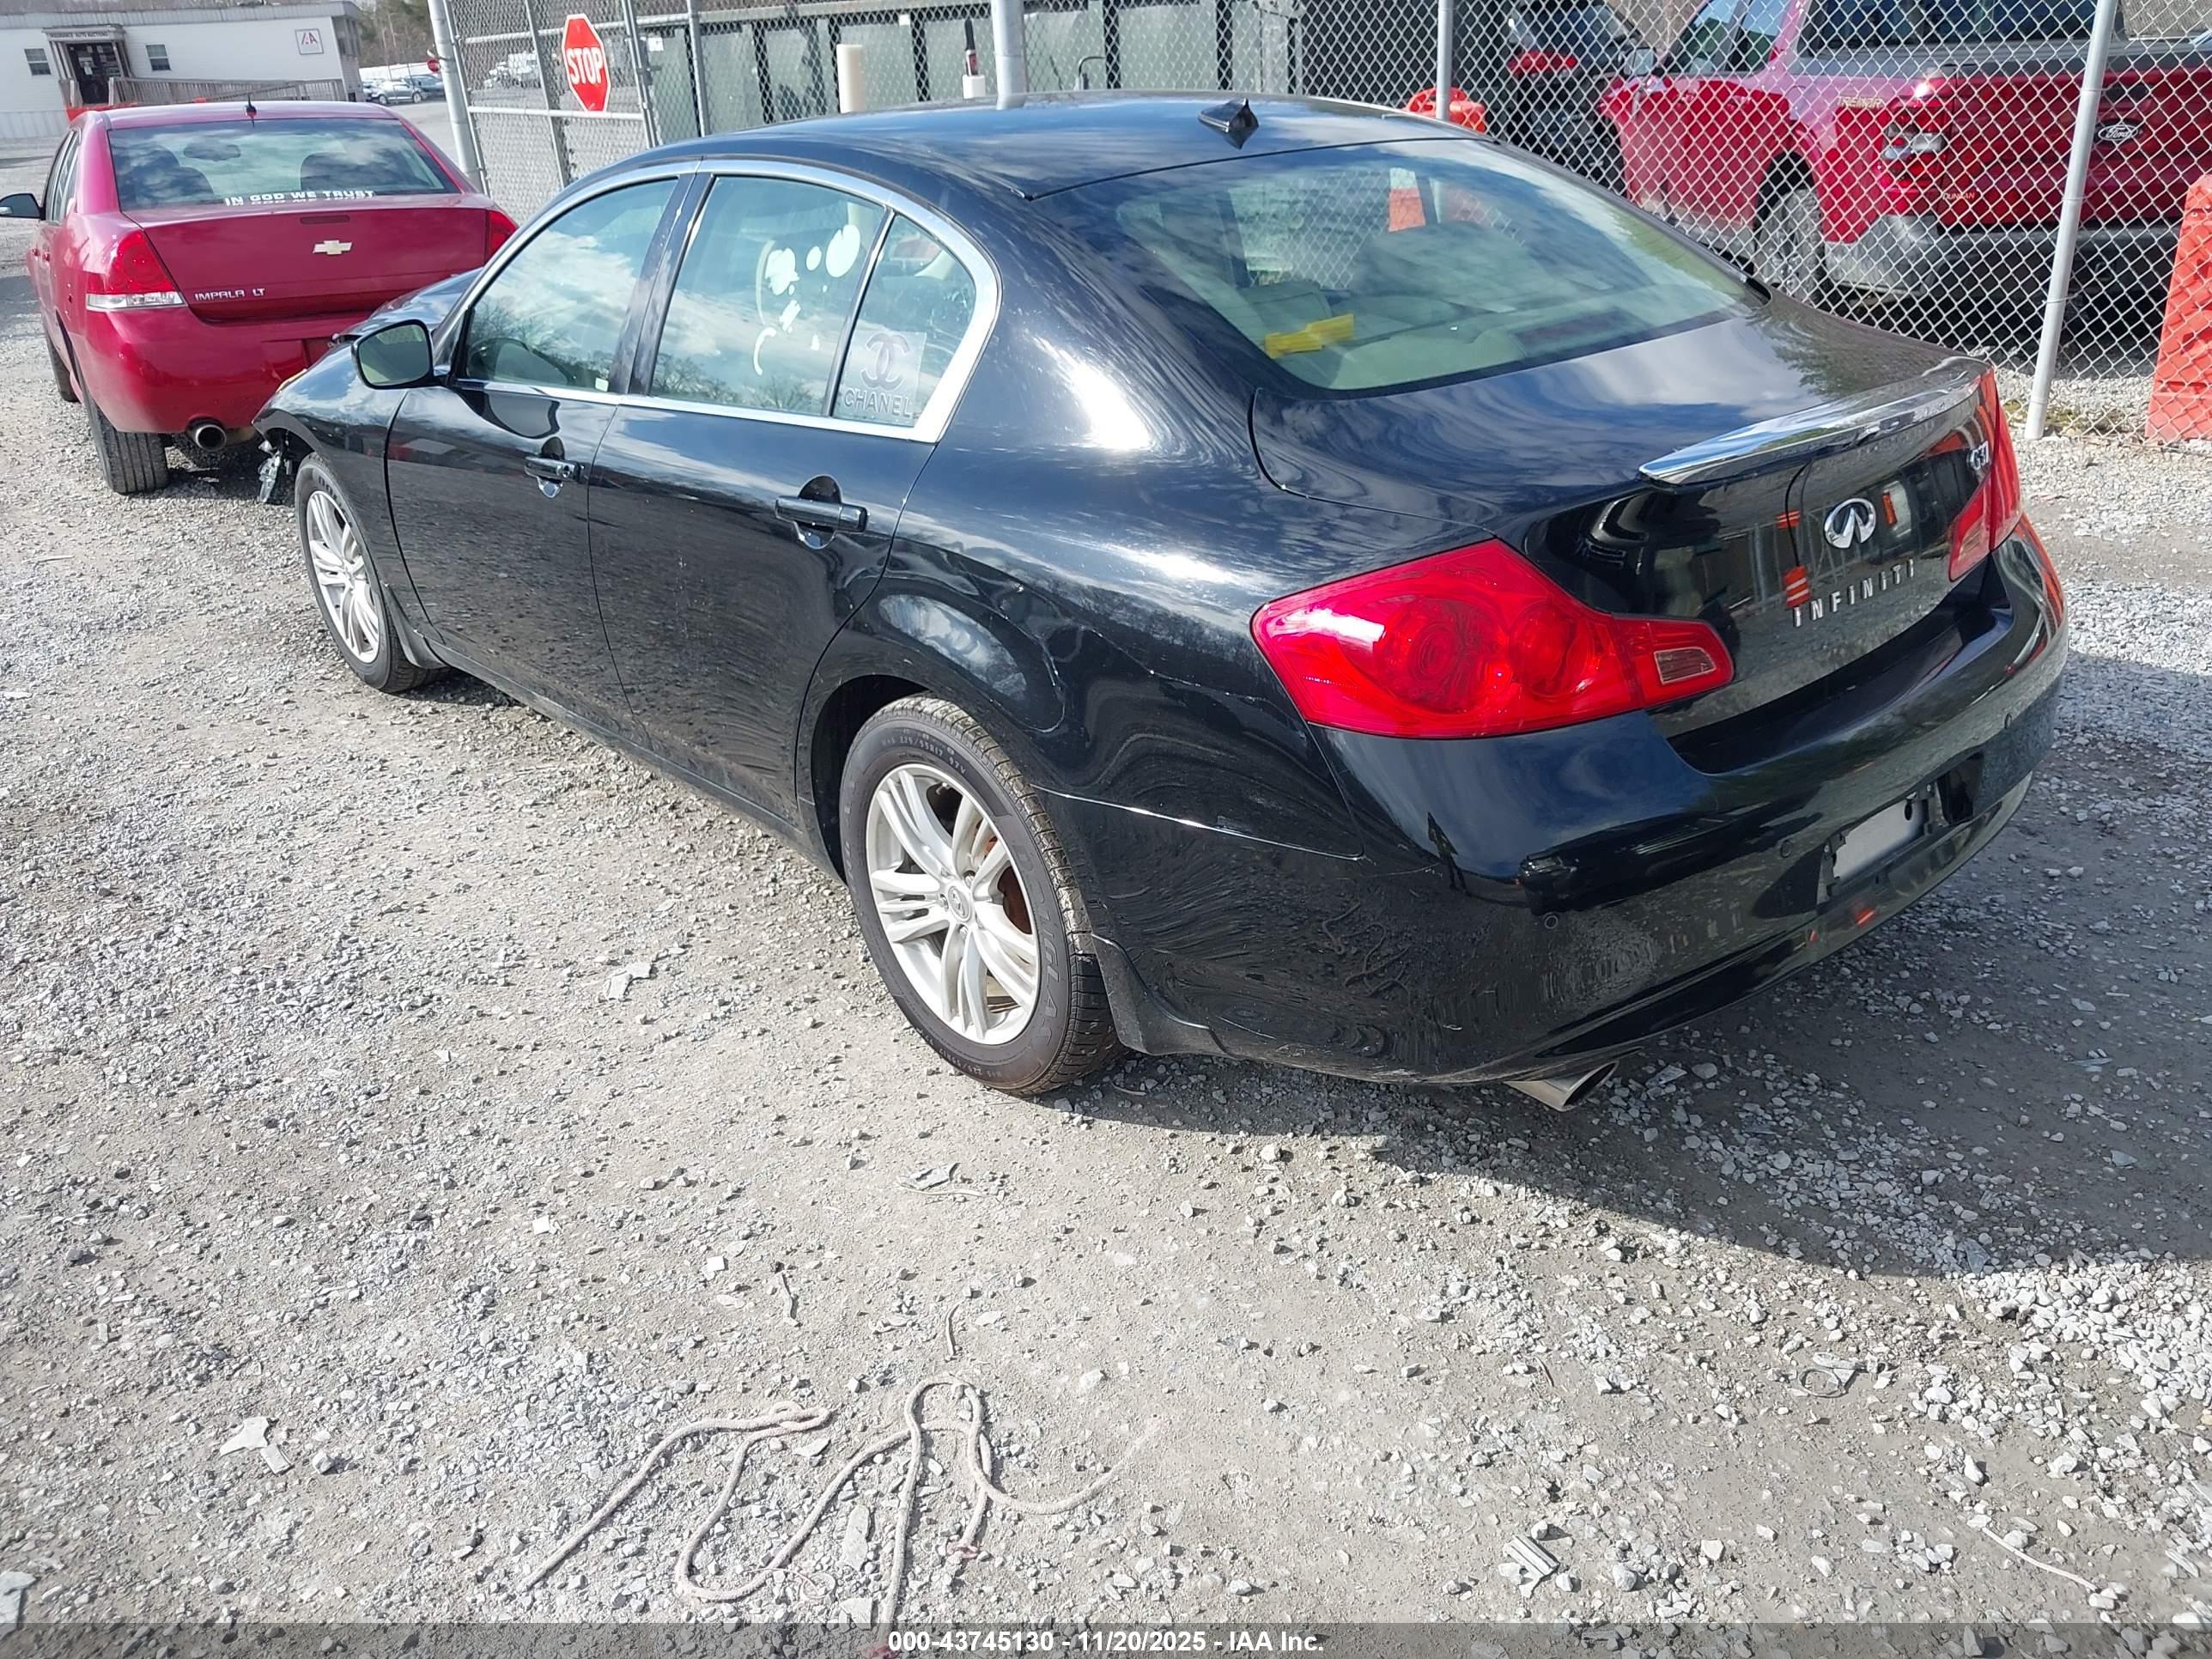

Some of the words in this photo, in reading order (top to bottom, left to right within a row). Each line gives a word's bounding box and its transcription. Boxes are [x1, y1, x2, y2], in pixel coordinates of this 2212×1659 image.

[565, 46, 604, 85] STOP
[2105, 126, 2131, 138] Ford
[224, 197, 244, 206] IN
[250, 193, 285, 202] GOD
[194, 289, 246, 301] IMPALA
[252, 288, 265, 296] LT
[843, 387, 913, 419] CHANEL
[1969, 440, 1990, 471] G37
[1792, 559, 1916, 628] INFINITI
